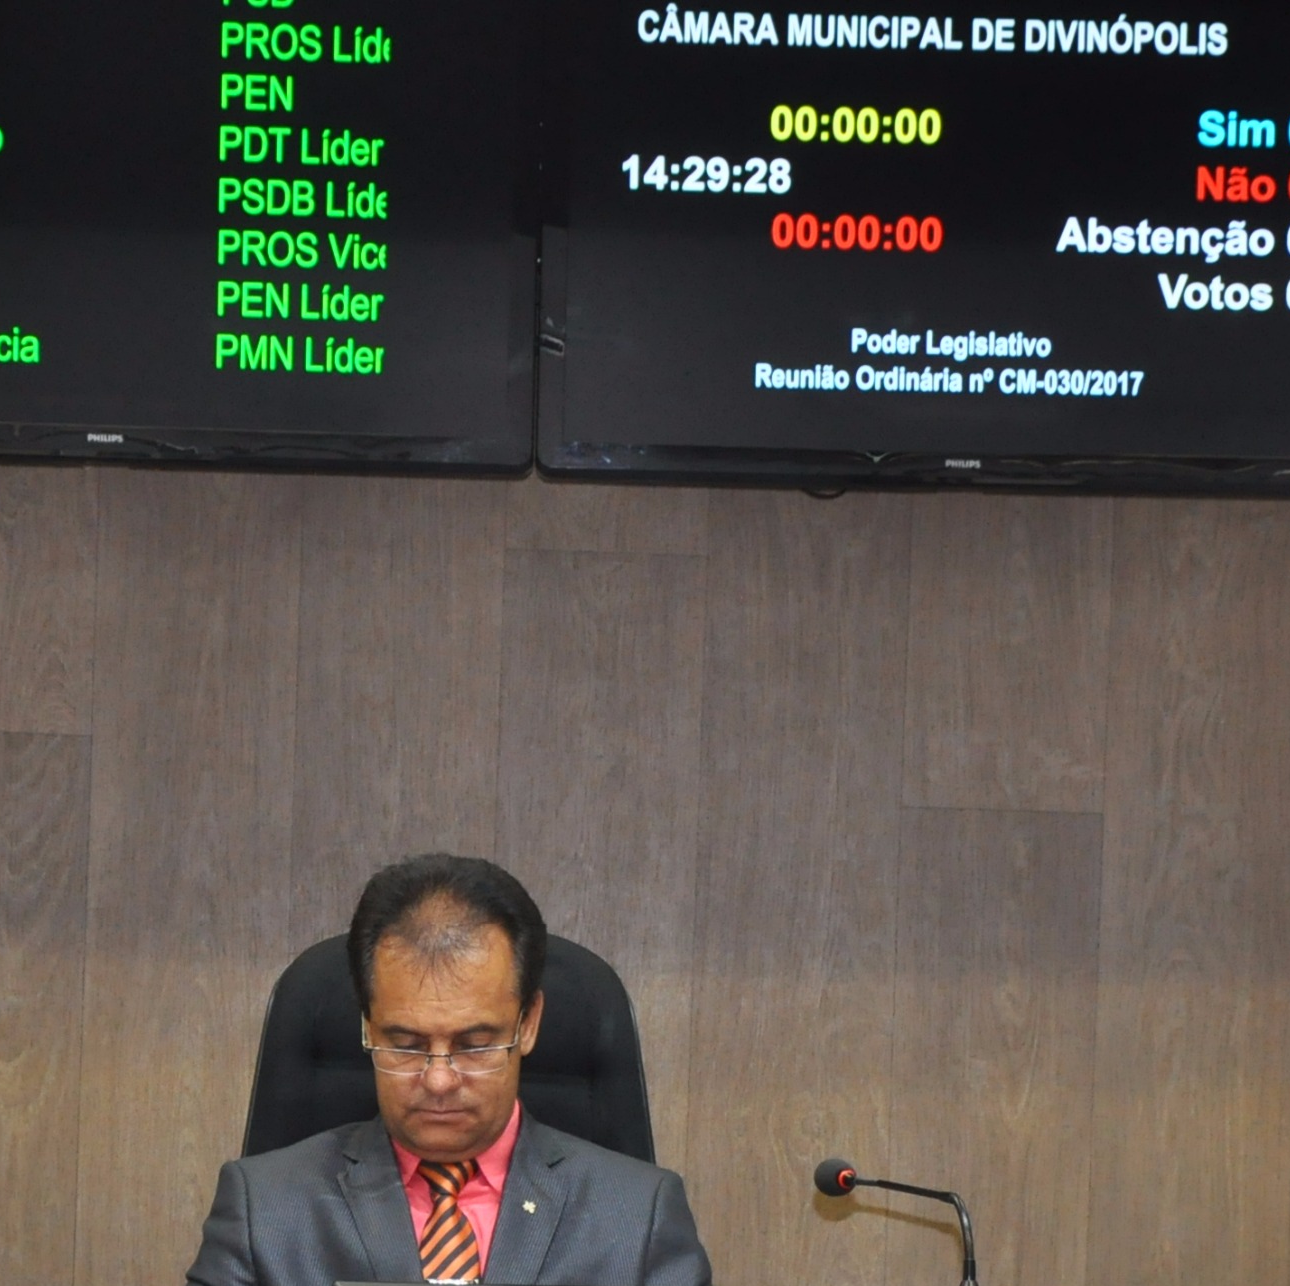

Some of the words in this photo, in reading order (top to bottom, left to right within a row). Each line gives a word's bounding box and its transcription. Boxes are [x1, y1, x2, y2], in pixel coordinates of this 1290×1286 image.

[220, 21, 323, 62] PROS
[637, 3, 779, 46] CÂMARA
[787, 13, 964, 51] MUNICIPAL
[971, 17, 1016, 52] DE
[1024, 13, 1228, 57] DIVINÓPOLIS
[220, 72, 294, 112] PEN
[770, 104, 942, 145] 00:00:00
[1196, 109, 1276, 148] Sim
[219, 124, 292, 164] PDT
[300, 127, 385, 167] Líder
[621, 153, 792, 195] 14:29:28
[1196, 165, 1277, 203] Não
[217, 177, 316, 217] PSDB
[217, 228, 320, 269] PROS
[770, 212, 944, 253] 00:00:00
[1055, 216, 1276, 264] Abstenção
[216, 280, 291, 320] PEN
[300, 282, 385, 323] Líder
[1157, 272, 1274, 312] Votos
[215, 332, 294, 372] PMN
[304, 336, 385, 375] Líder
[850, 327, 922, 356] Poder
[925, 329, 1053, 363] Legislativo
[754, 362, 851, 391] Reunião
[854, 364, 964, 394] Ordinária
[998, 367, 1145, 397] CM-030/2017
[87, 433, 124, 443] PHILIPS
[945, 459, 981, 469] PHILIPS
